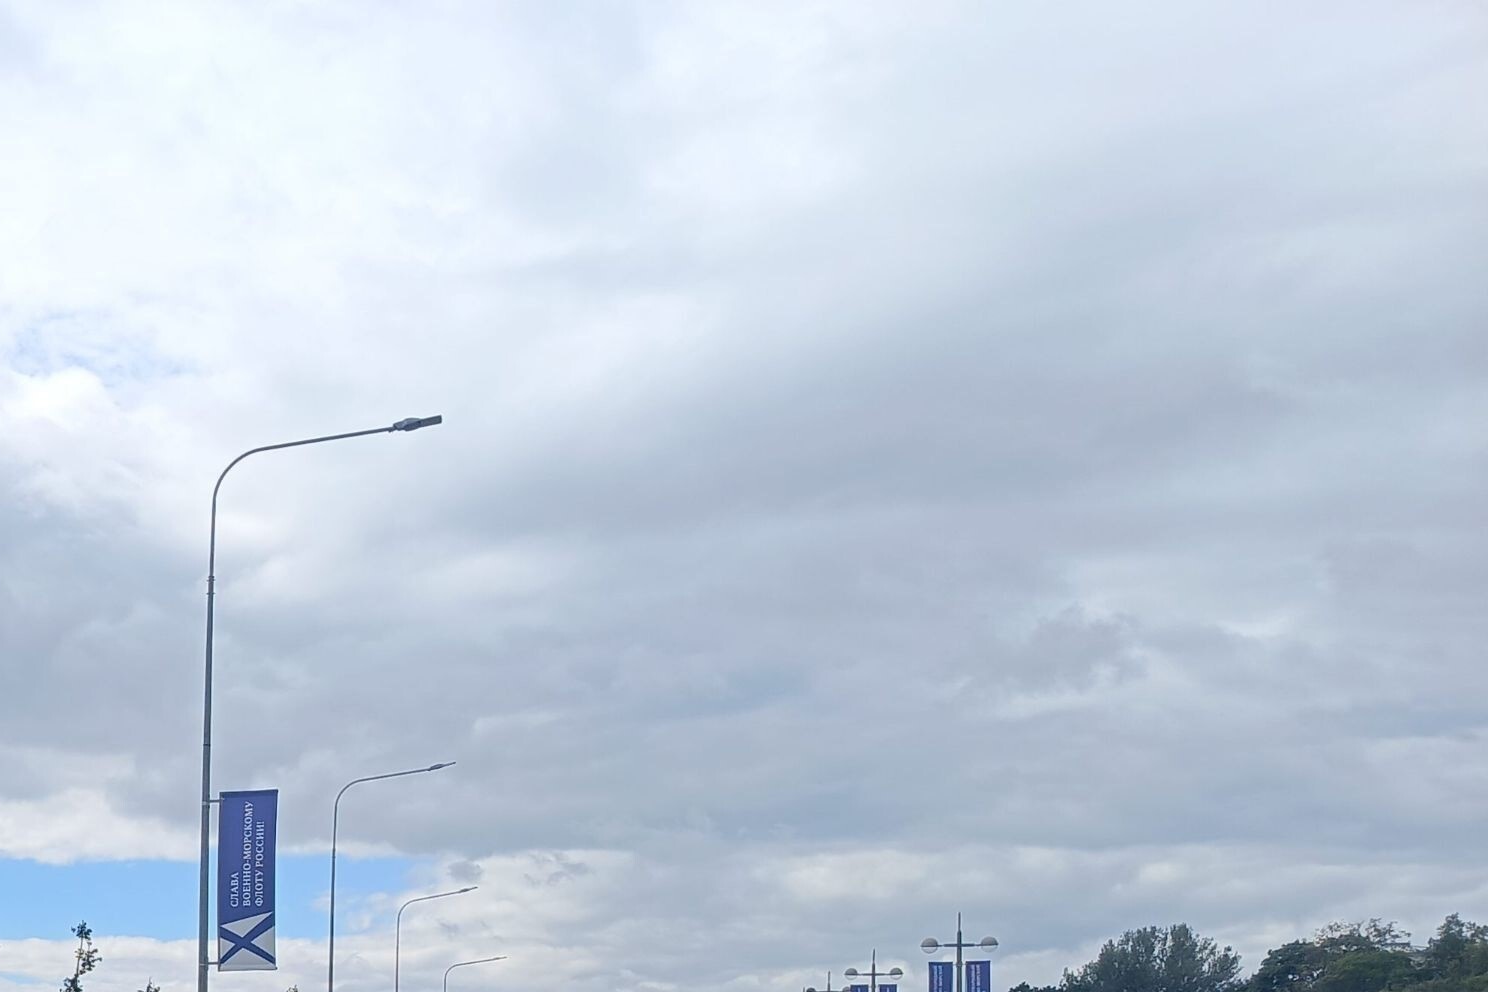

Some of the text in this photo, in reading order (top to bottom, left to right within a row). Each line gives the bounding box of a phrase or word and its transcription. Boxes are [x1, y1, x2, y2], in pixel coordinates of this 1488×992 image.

[230, 872, 239, 907] СЛАВА
[242, 801, 253, 906] ВОЕННО-МОРСКОМУ
[254, 821, 265, 907] ФЛОТУ РОССИИ!
